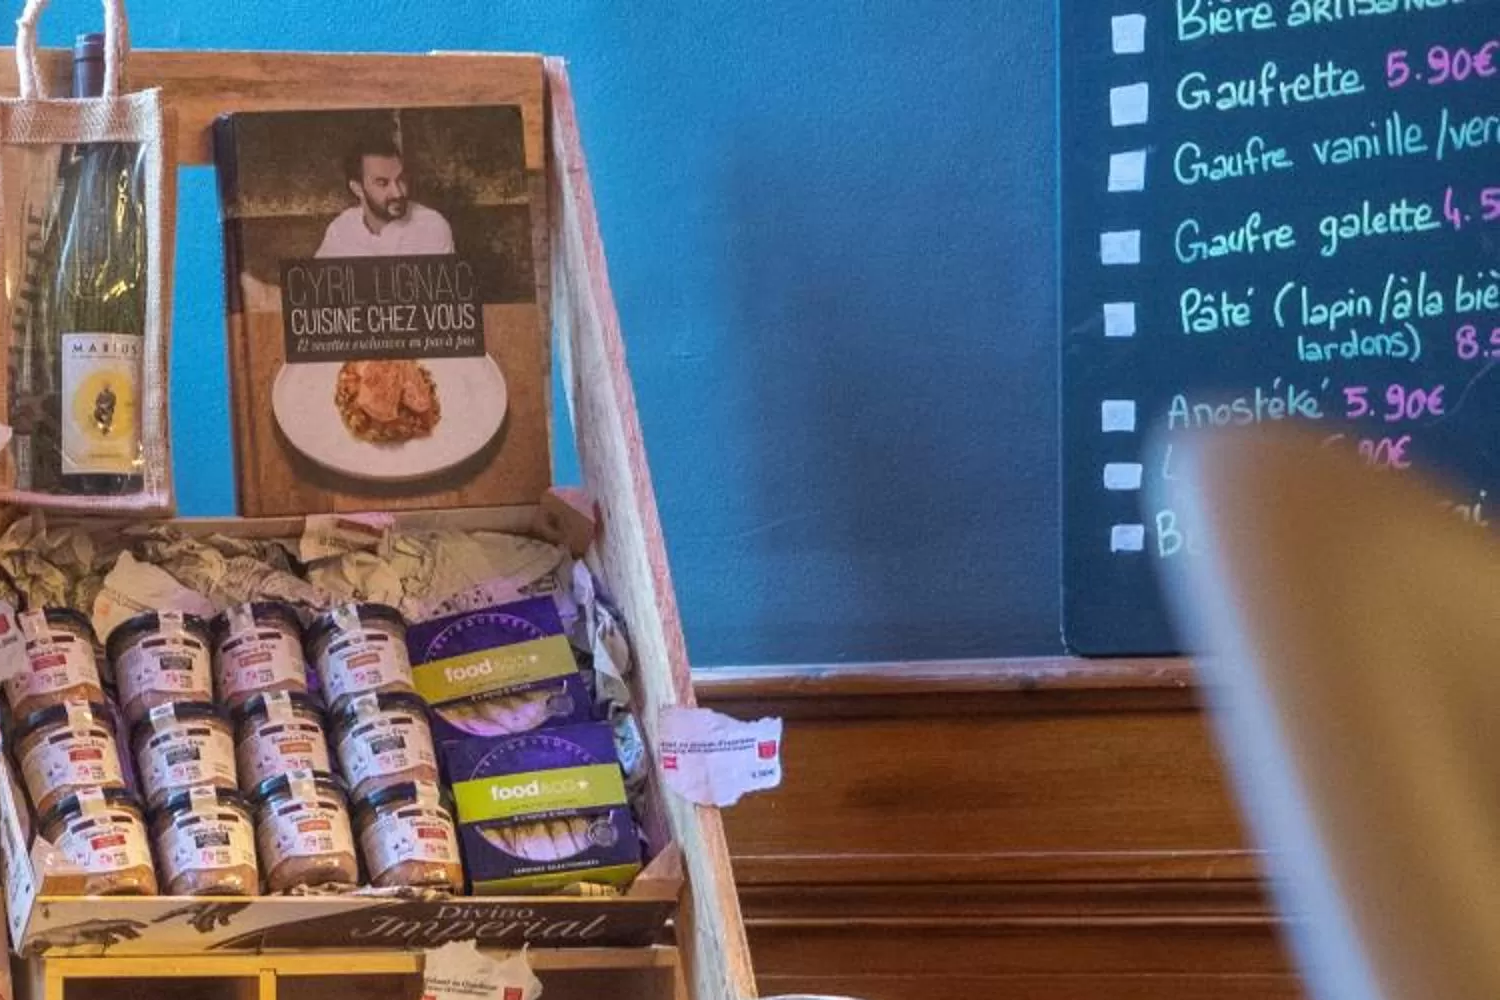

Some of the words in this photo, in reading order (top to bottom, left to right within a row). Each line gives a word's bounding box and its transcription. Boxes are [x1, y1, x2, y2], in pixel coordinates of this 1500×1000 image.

[1176, 61, 1365, 111] Gaufrette
[1386, 40, 1500, 89] 5.90€
[1174, 135, 1294, 185] Gaufre
[1175, 211, 1296, 263] Gaufre
[1319, 198, 1441, 257] galette
[287, 263, 365, 306] CYRIL
[374, 260, 475, 303] LIGNAC
[290, 306, 365, 335] CUISINE
[367, 304, 419, 333] CHEZ
[422, 303, 476, 331] VOUS
[1180, 286, 1255, 334] Pâté
[71, 342, 138, 353] MARIUS
[1343, 383, 1445, 421] 5.90€
[350, 914, 609, 944] Imperial
[435, 904, 534, 920] Divino
